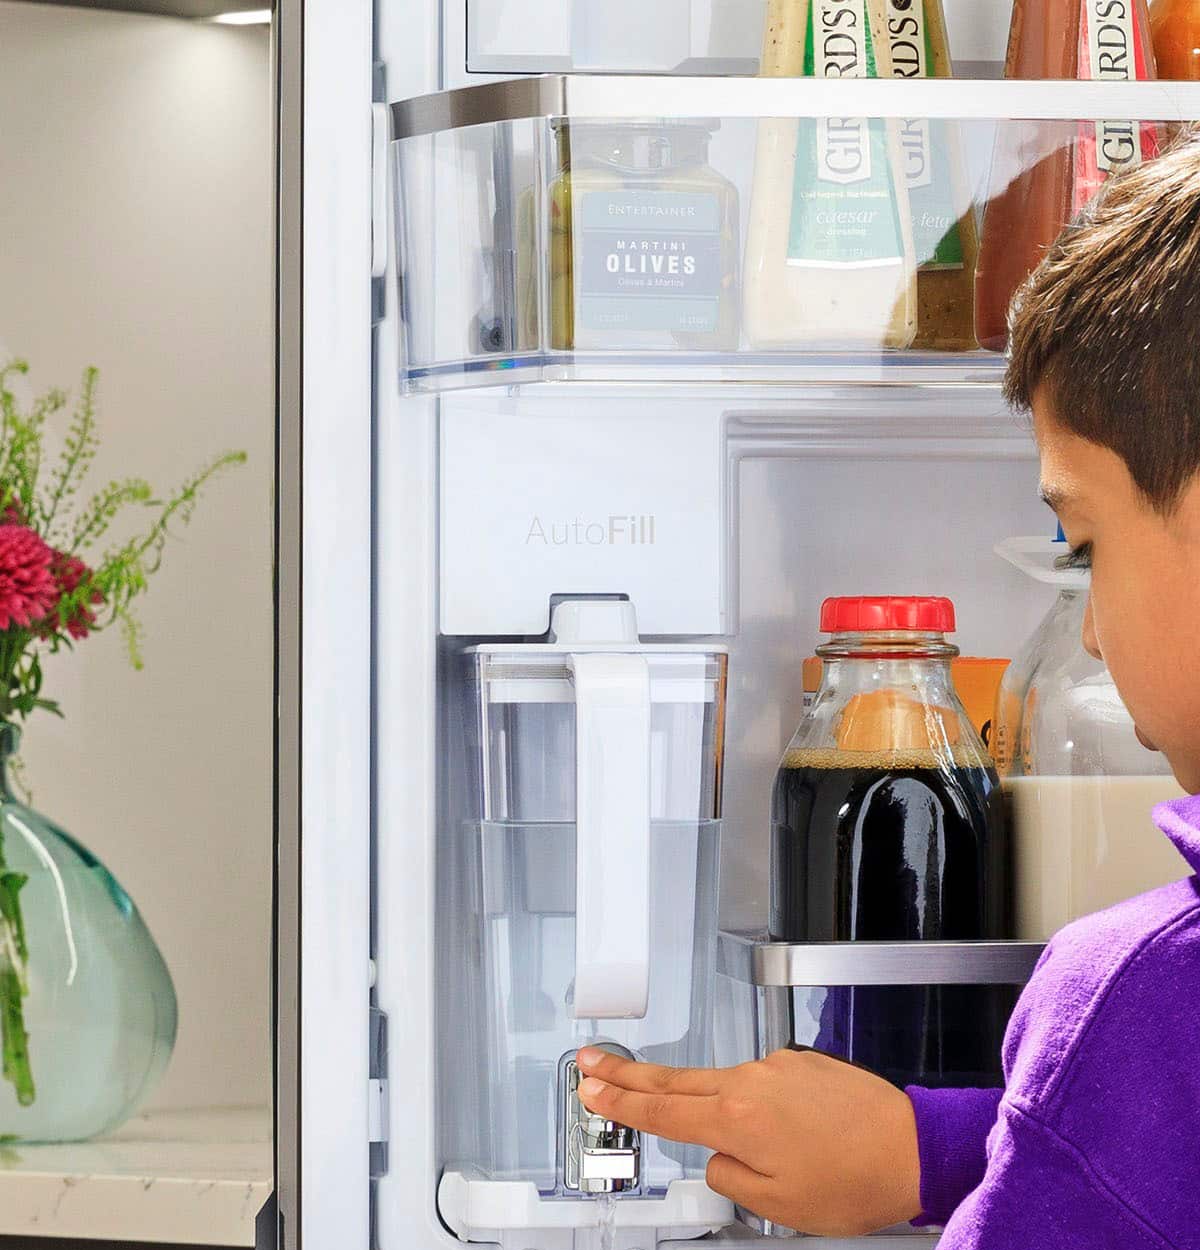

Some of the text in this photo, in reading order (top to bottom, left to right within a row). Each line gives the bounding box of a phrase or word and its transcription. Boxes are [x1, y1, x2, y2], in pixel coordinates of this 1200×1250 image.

[608, 205, 696, 217] ENTERTAINER
[816, 209, 878, 225] caesar
[616, 240, 686, 251] MARTINI
[606, 254, 696, 274] OLIVES
[525, 515, 656, 545] AutoFill
